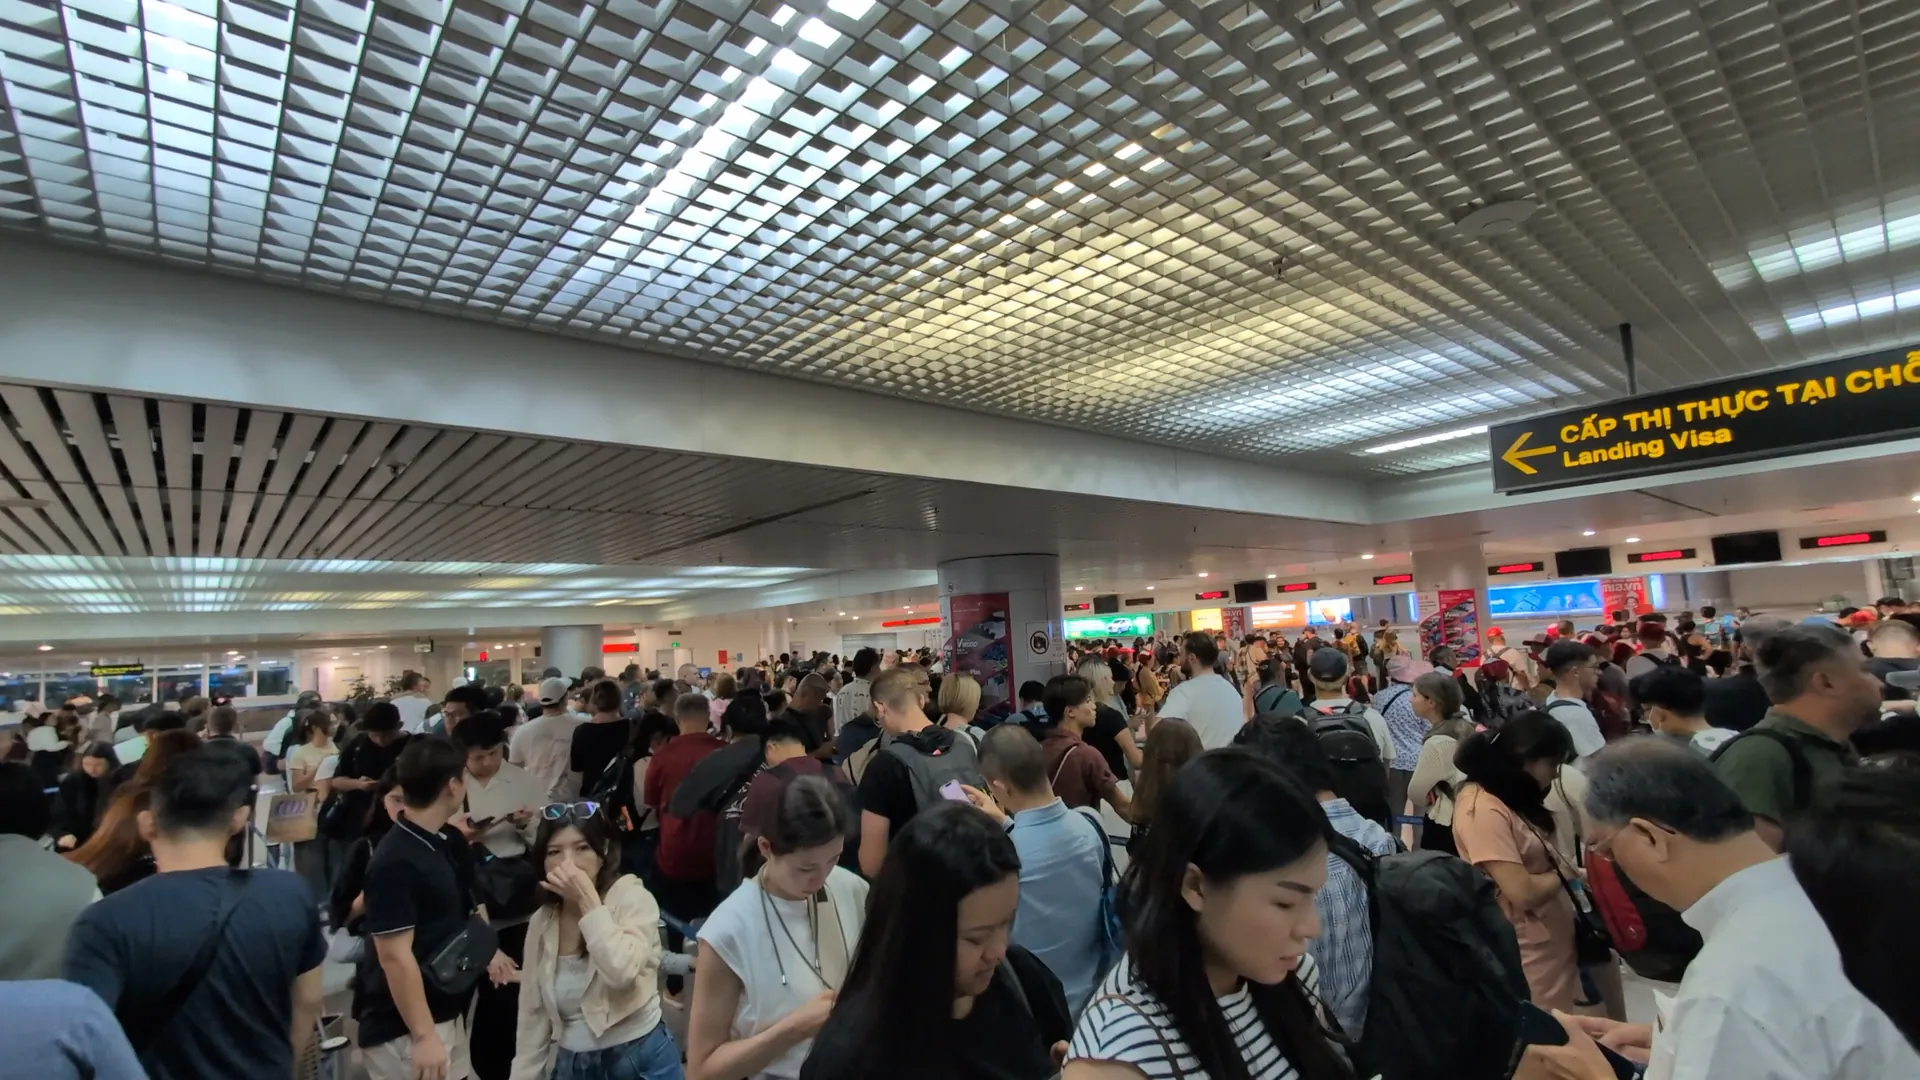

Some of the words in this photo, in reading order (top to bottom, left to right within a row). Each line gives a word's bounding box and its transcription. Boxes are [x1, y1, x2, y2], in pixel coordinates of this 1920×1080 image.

[1560, 413, 1617, 444] CẤP
[1623, 407, 1672, 432] THỊ
[1677, 390, 1769, 422] THỰC
[1776, 375, 1836, 405] TẠI
[1563, 439, 1664, 467] Landing
[1670, 428, 1732, 450] Visa
